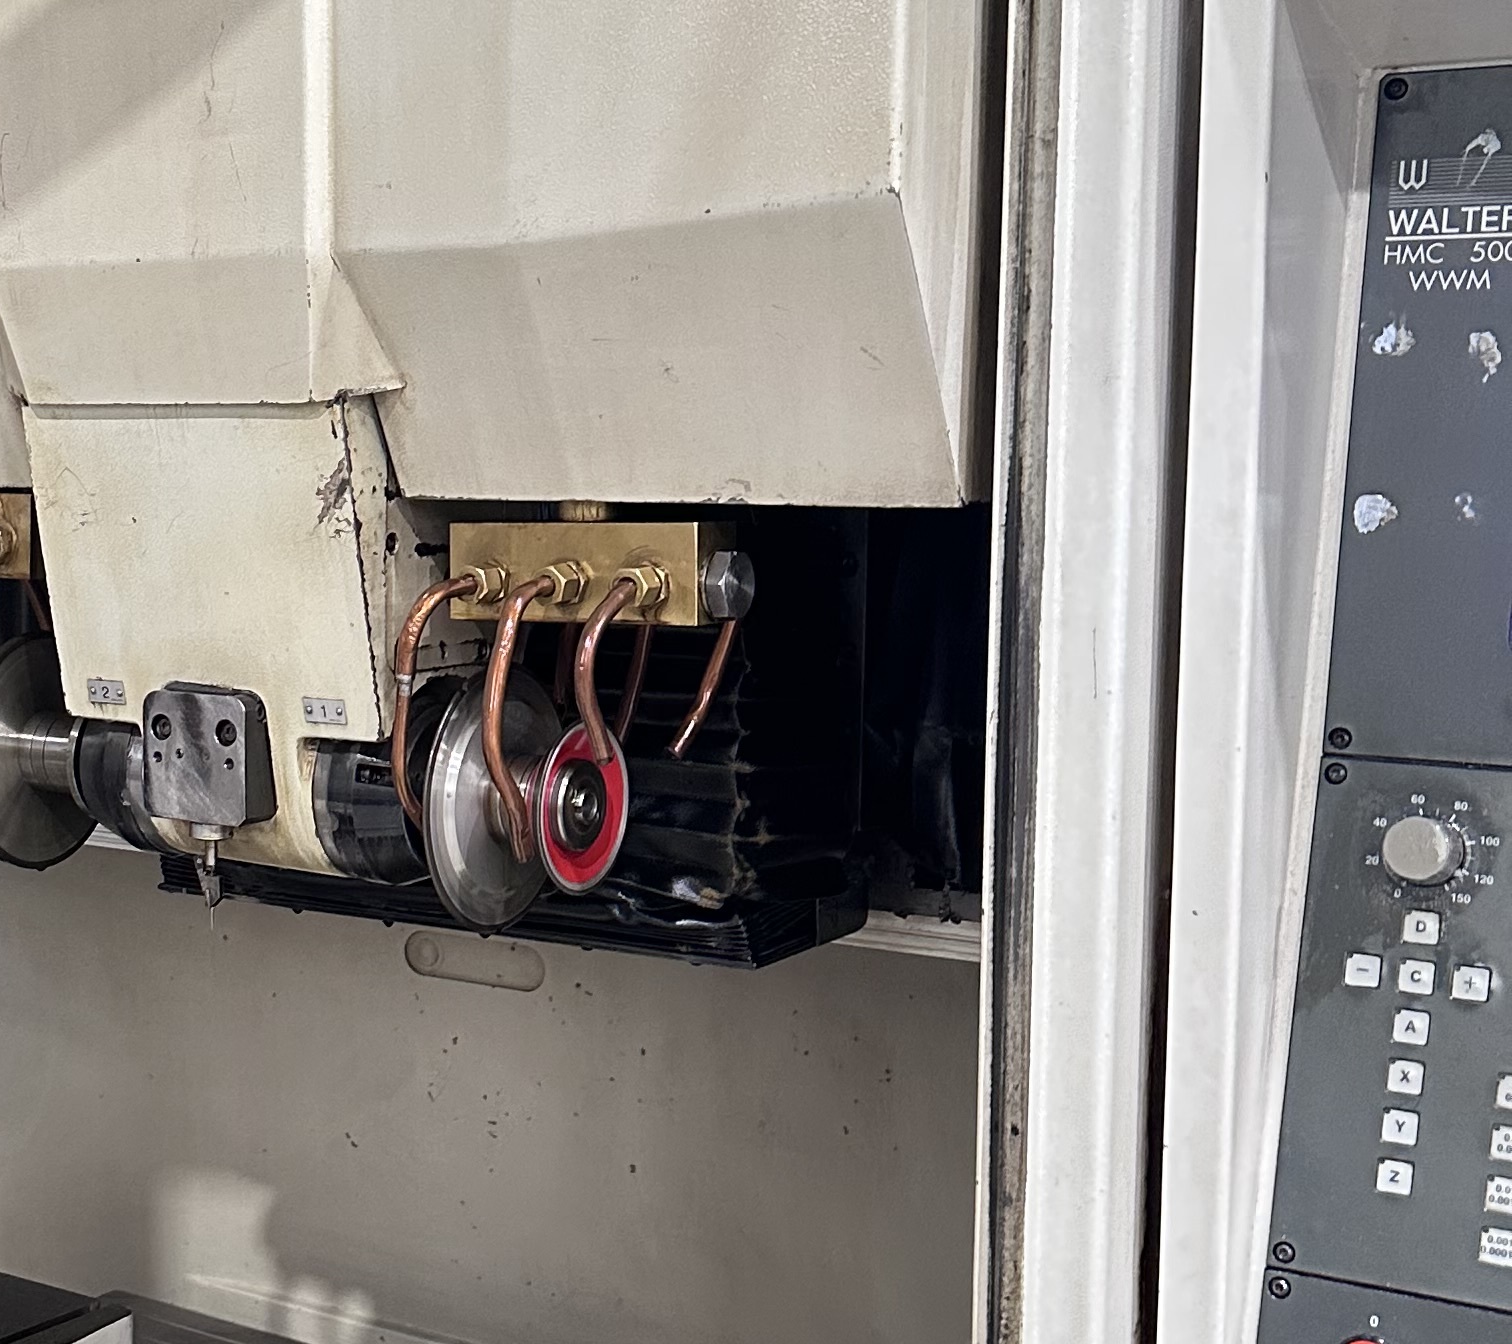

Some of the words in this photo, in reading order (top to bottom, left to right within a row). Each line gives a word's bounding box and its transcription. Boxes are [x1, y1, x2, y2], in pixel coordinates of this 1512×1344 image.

[1383, 242, 1445, 265] HMC
[1409, 268, 1491, 291] WWM
[101, 686, 109, 698] 2
[320, 705, 327, 717] 1
[1410, 794, 1426, 804] 60
[1453, 801, 1468, 811] 80
[1373, 817, 1387, 827] 40
[1480, 836, 1500, 847] 100
[1365, 855, 1379, 865] 20
[1474, 874, 1494, 885] 120
[1393, 888, 1402, 898] 0
[1451, 893, 1472, 904] 150
[1415, 920, 1427, 933] D
[1410, 970, 1422, 983] C
[1404, 1020, 1416, 1033] A
[1400, 1069, 1410, 1083] X
[1395, 1119, 1406, 1133] Y
[1389, 1169, 1400, 1183] Z
[1488, 1194, 1512, 1205] 0.00
[1487, 1234, 1512, 1247] 0.00
[1369, 1315, 1379, 1327] 0
